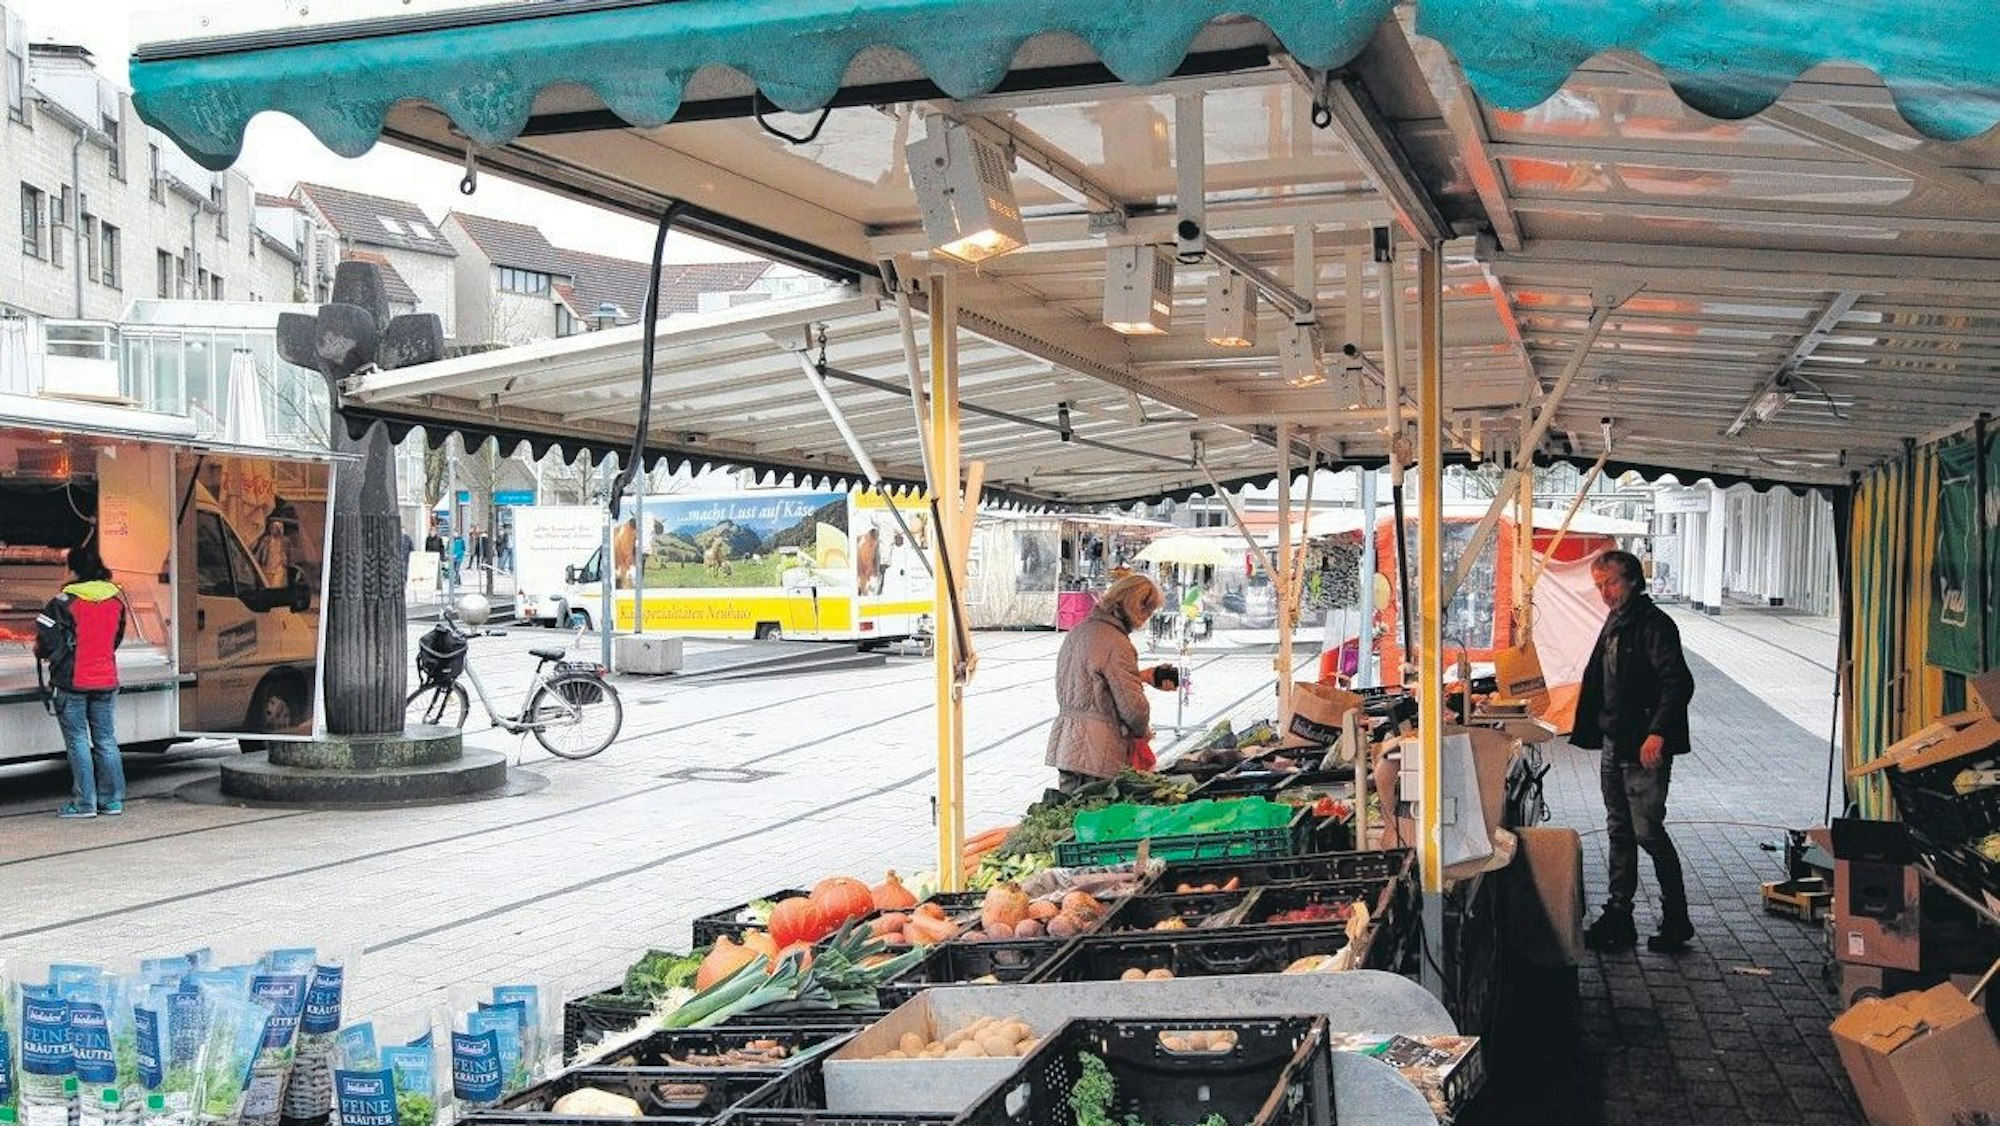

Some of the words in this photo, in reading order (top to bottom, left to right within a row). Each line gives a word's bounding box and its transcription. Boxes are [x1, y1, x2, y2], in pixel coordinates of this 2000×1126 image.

[728, 503, 758, 520] Lust
[760, 500, 783, 524] auf
[783, 500, 814, 518] Käse
[706, 602, 752, 620] Neuhaus
[454, 1057, 499, 1073] FEINE
[454, 1071, 499, 1083] KRÄUTER
[341, 1100, 393, 1115] FEINE
[343, 1114, 394, 1126] KRÄUTER
